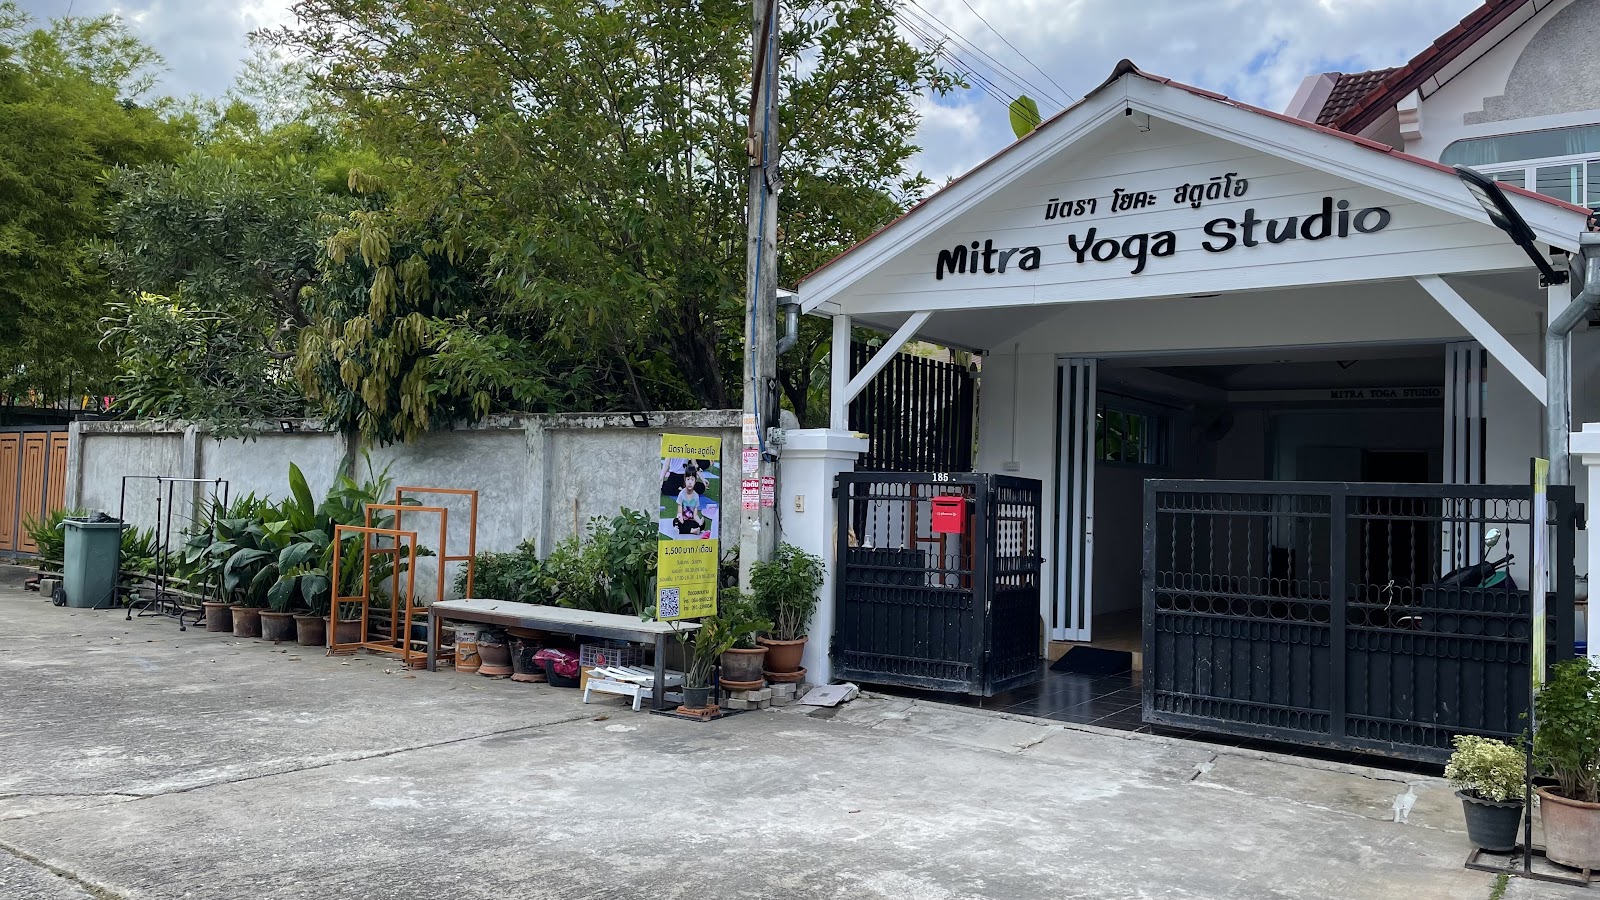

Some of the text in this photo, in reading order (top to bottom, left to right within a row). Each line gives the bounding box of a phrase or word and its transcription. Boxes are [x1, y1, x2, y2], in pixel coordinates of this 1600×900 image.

[1045, 172, 1248, 221] มิตรา โยคะ สตูดิโอ
[935, 196, 1392, 280] Mitra Yoga Studio
[1330, 388, 1441, 399] MITRA YOGA STUDIO
[668, 443, 716, 457] มิตรา โยคะ สตูดิโอ
[932, 472, 949, 482] 185
